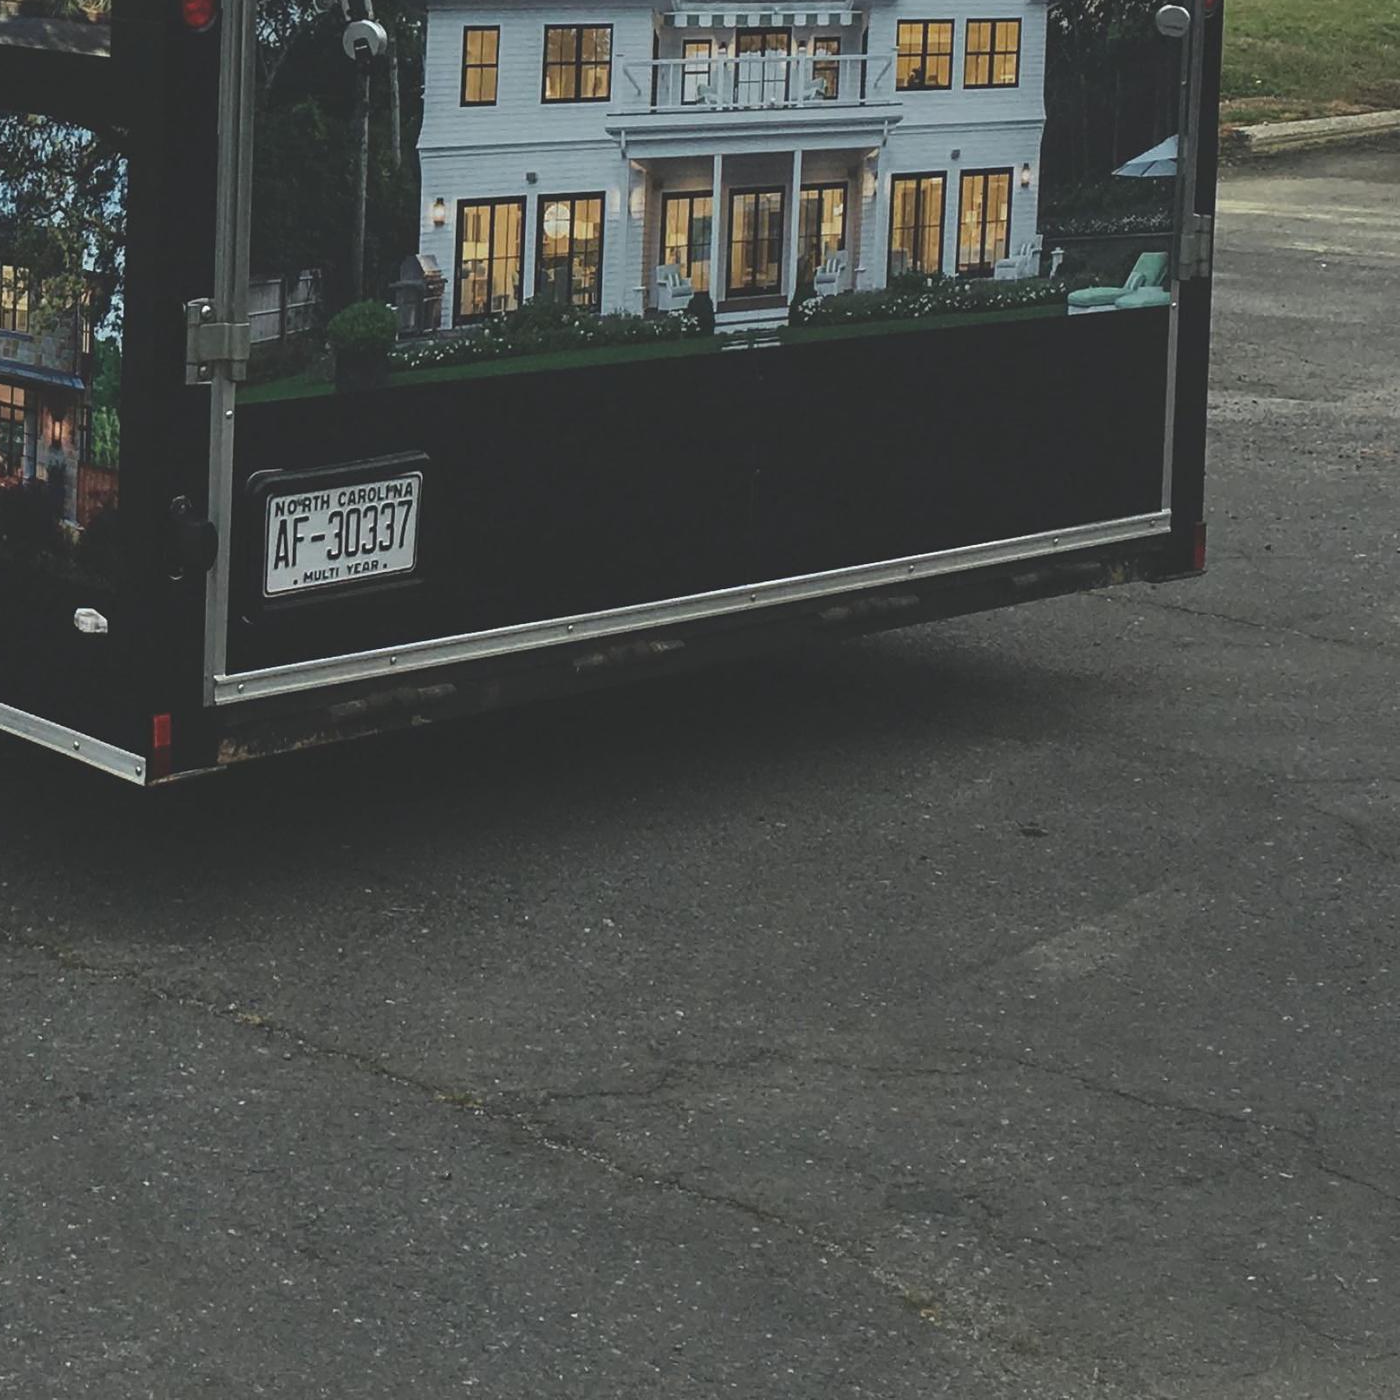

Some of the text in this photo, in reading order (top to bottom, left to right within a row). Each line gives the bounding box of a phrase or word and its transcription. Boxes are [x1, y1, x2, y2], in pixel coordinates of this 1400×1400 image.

[274, 482, 414, 518] NORTH CAROLINA
[274, 499, 413, 570] AF-30337
[303, 560, 379, 583] MULTI YEAR
